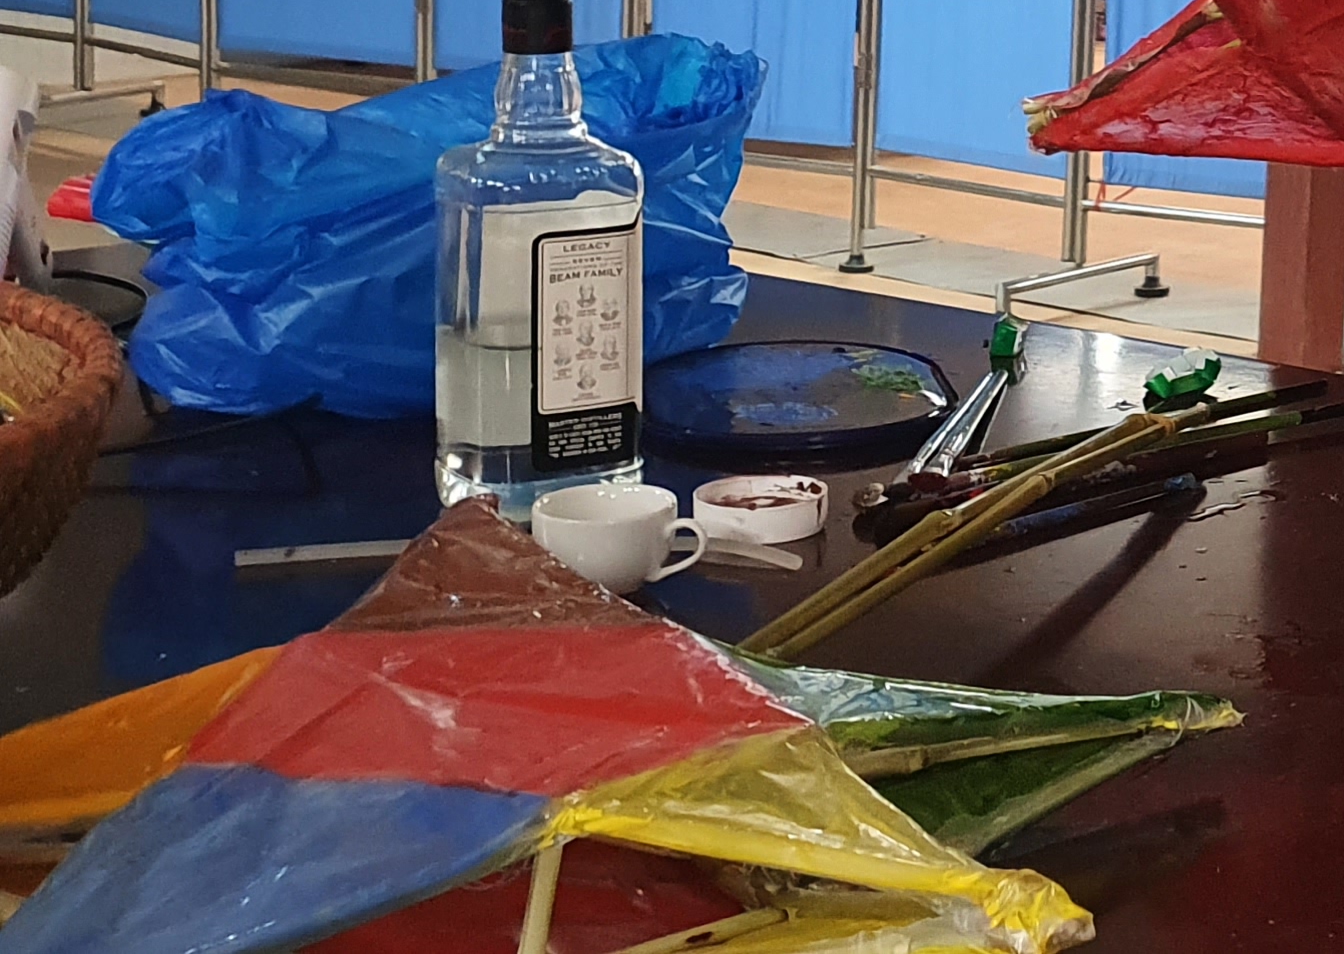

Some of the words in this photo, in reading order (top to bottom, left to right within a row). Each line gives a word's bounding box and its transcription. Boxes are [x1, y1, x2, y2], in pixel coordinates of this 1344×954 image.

[562, 241, 611, 253] LEGACY
[549, 272, 581, 283] BEAM
[583, 267, 623, 278] FAMILY
